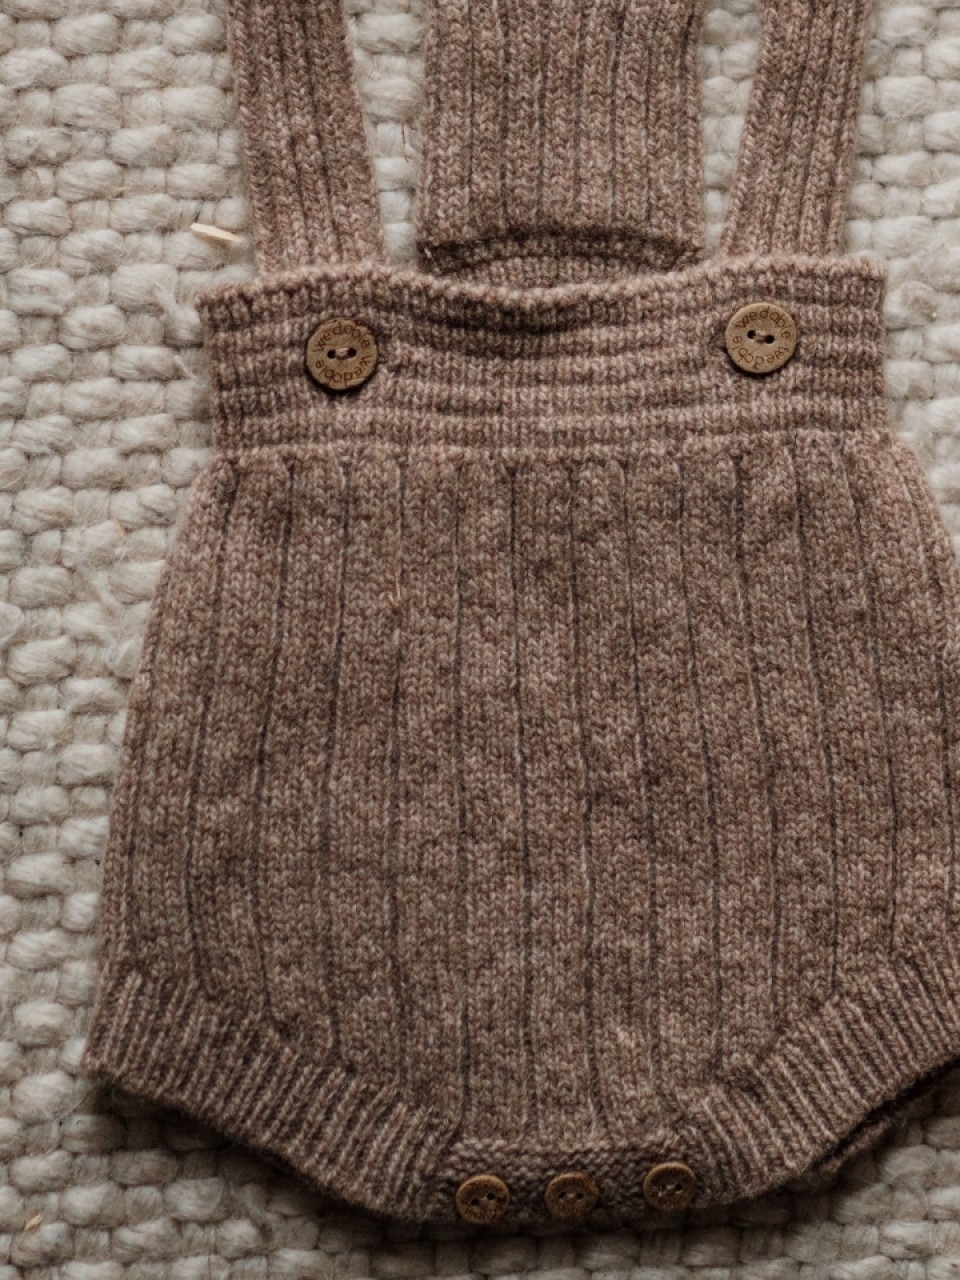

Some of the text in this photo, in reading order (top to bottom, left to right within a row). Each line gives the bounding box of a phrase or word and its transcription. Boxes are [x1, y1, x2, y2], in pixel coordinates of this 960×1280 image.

[312, 321, 370, 352] wedoble
[735, 306, 793, 339] wedoble
[732, 335, 790, 370] wedoble
[316, 356, 373, 387] wedoble
